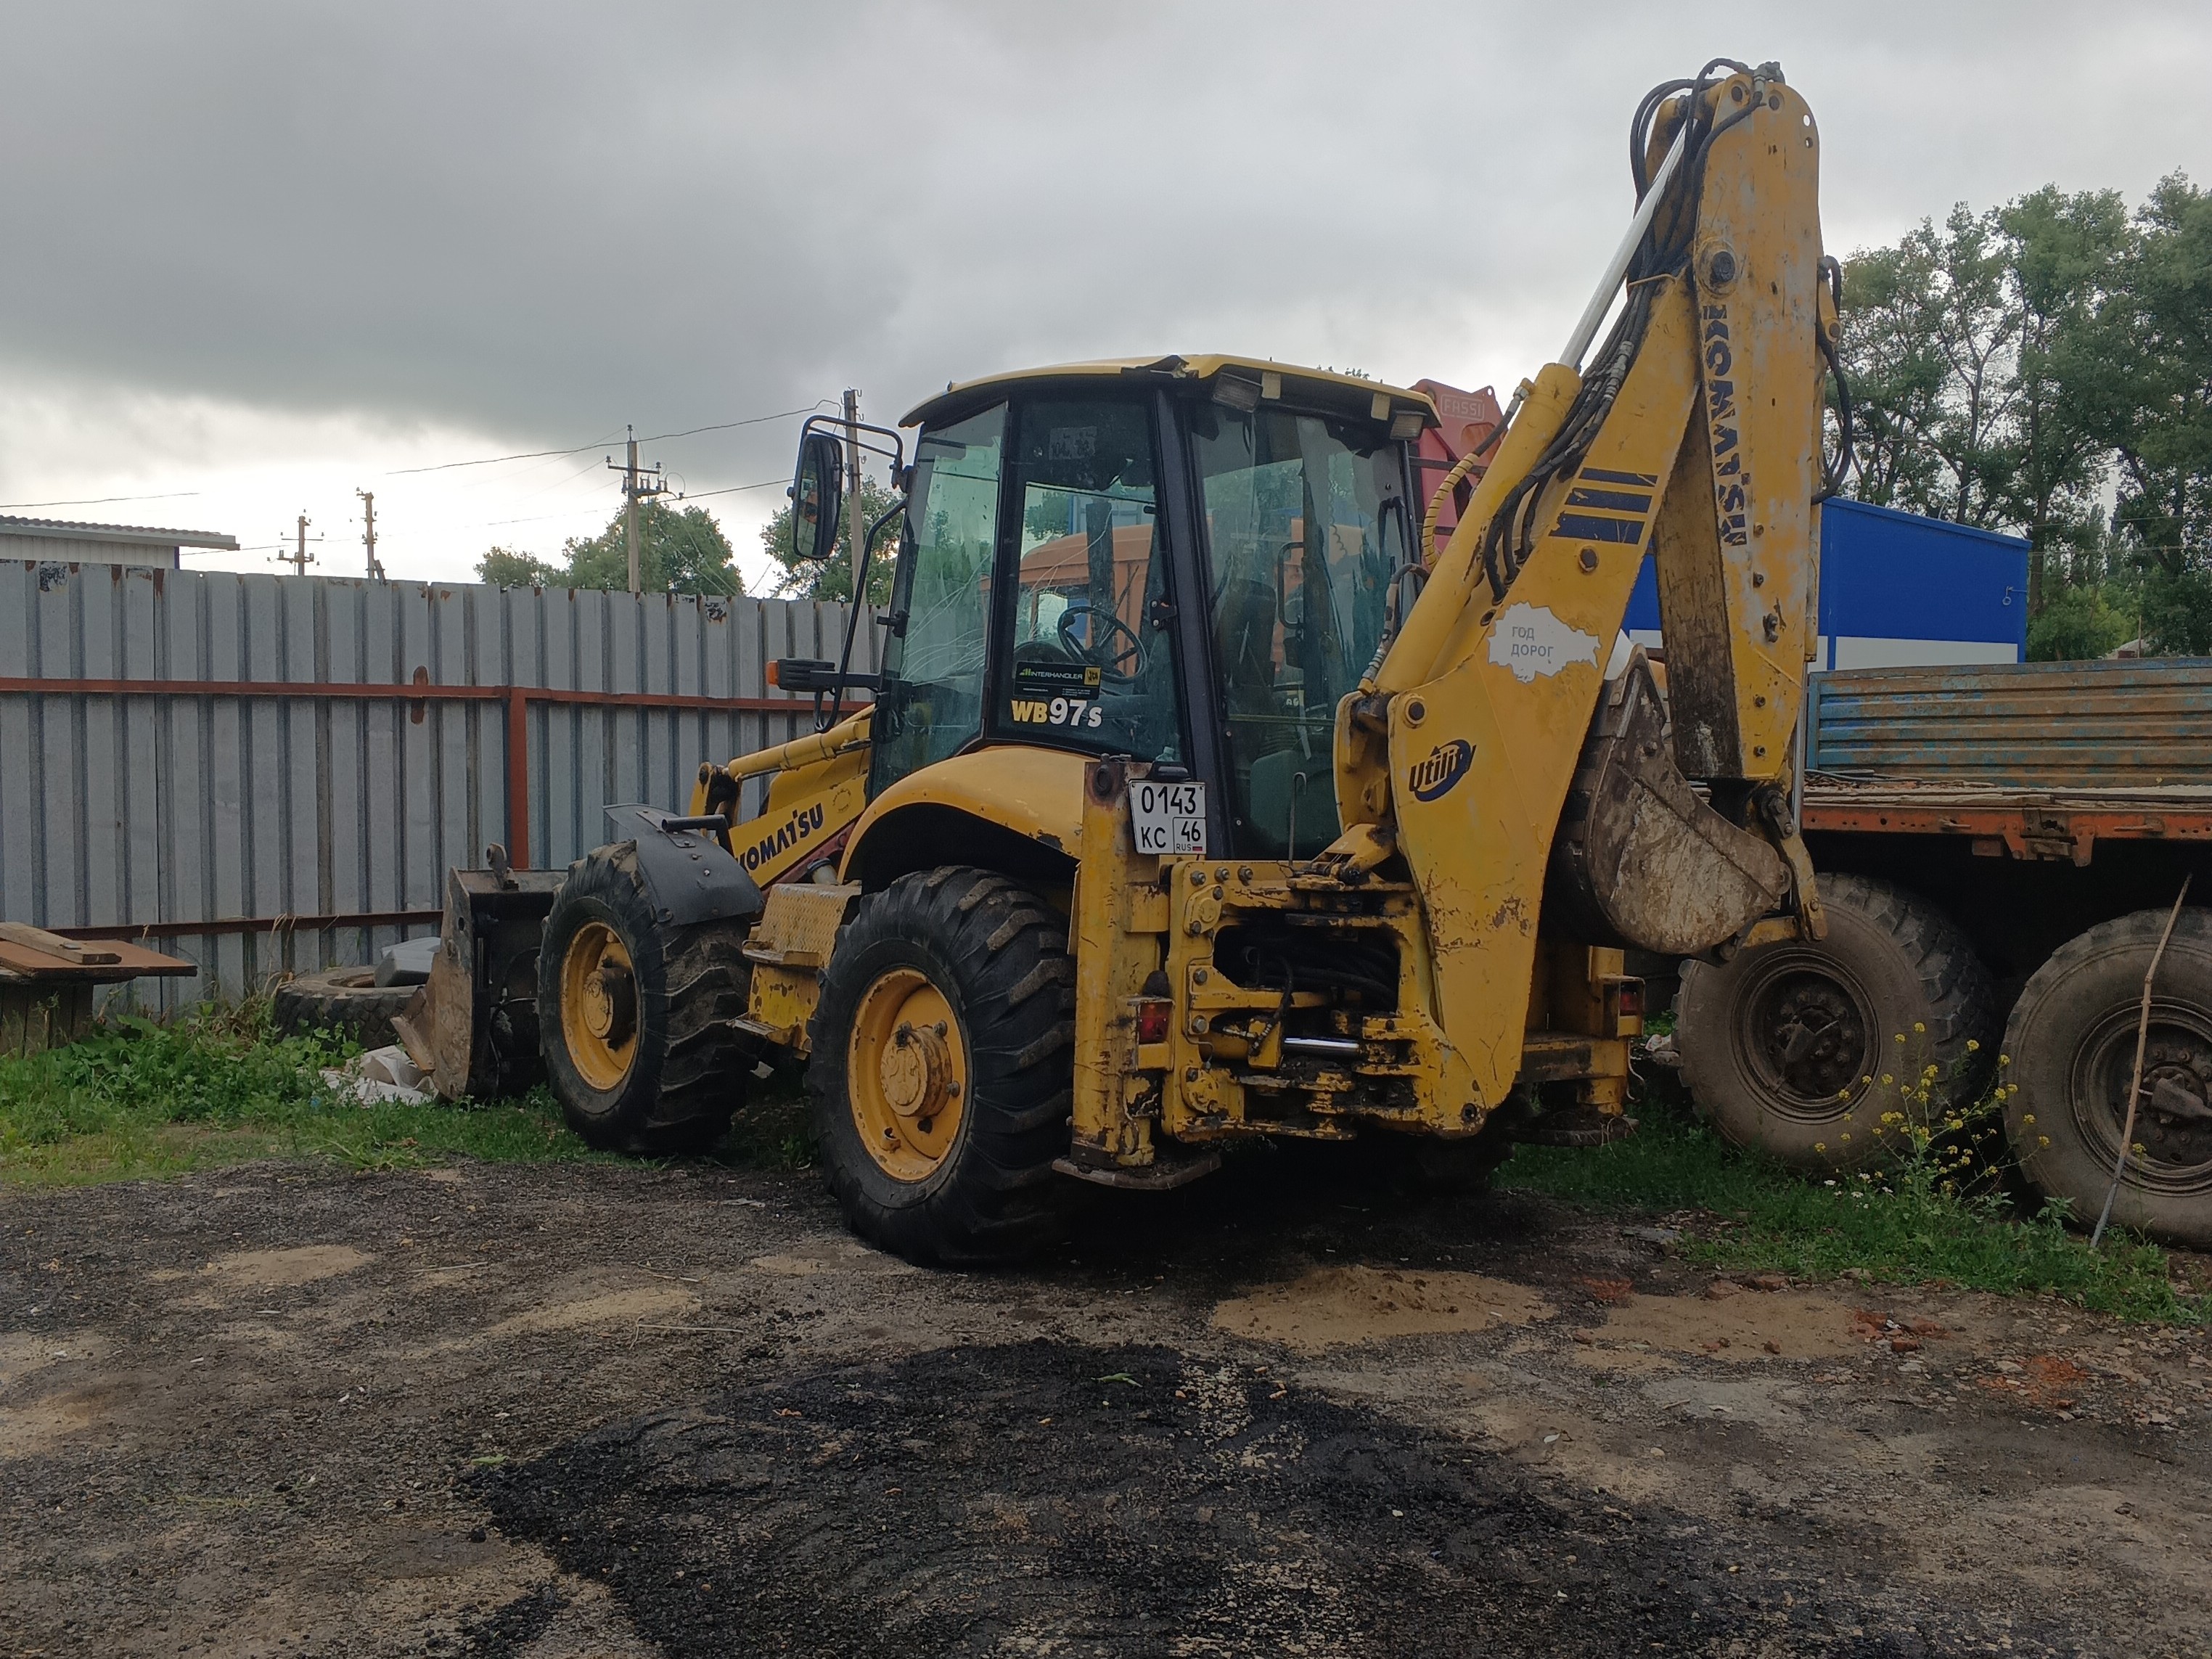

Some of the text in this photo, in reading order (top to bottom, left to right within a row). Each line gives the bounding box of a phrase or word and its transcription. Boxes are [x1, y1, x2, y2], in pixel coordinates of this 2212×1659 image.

[1443, 398, 1481, 417] FASSI
[1702, 304, 1749, 546] KOMATSU
[1512, 626, 1534, 641] ГОД
[1511, 644, 1554, 658] ДОРОГ
[1031, 671, 1084, 680] INTERHANDLER
[1142, 786, 1196, 814] 0143
[1181, 821, 1201, 842] 46
